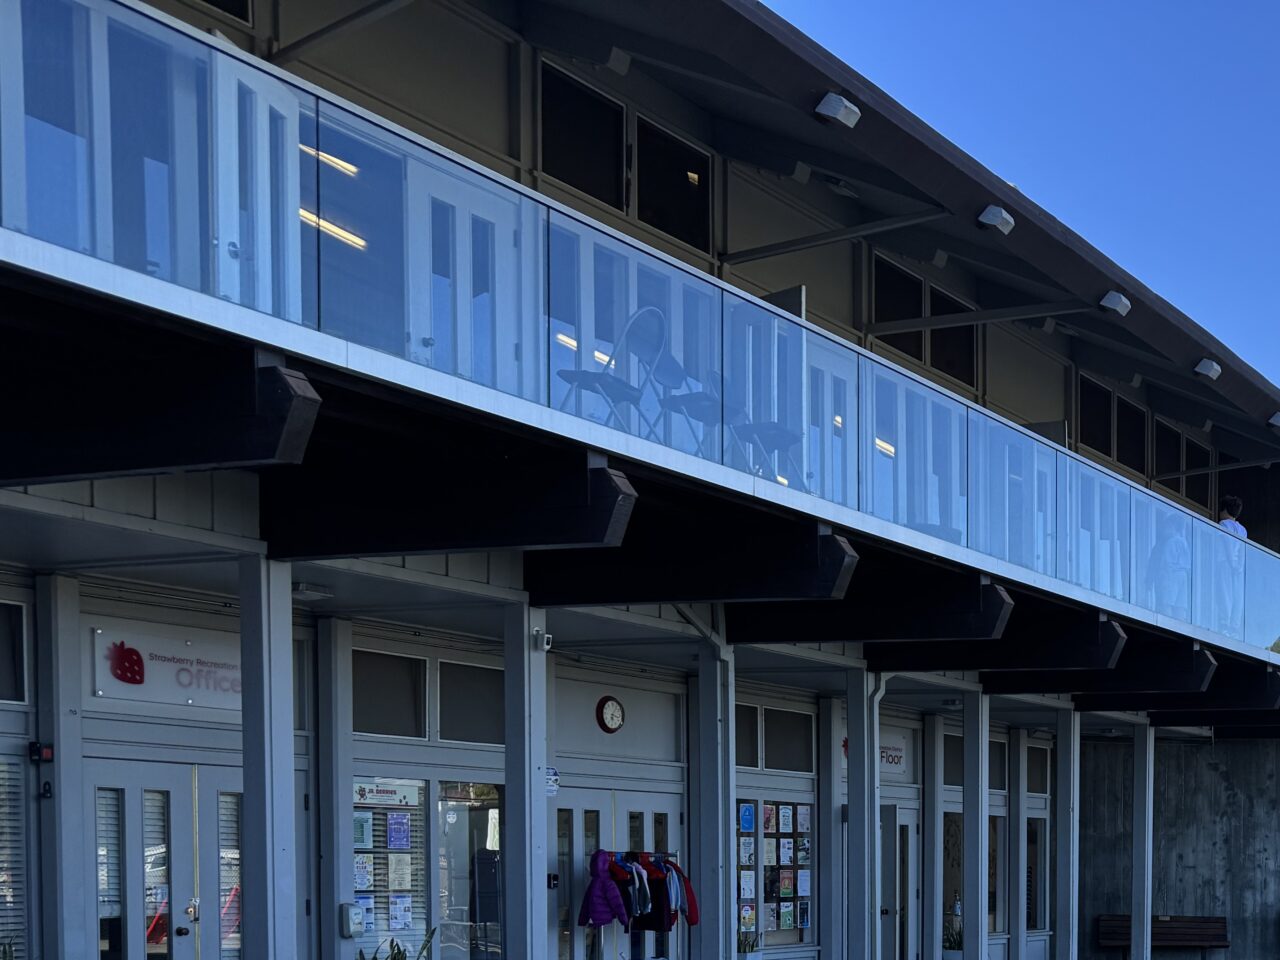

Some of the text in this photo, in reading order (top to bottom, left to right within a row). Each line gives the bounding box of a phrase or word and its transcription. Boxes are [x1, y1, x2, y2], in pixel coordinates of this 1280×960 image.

[149, 652, 238, 670] Strawberry Recreation
[176, 667, 241, 693] Office
[881, 750, 903, 766] Floor
